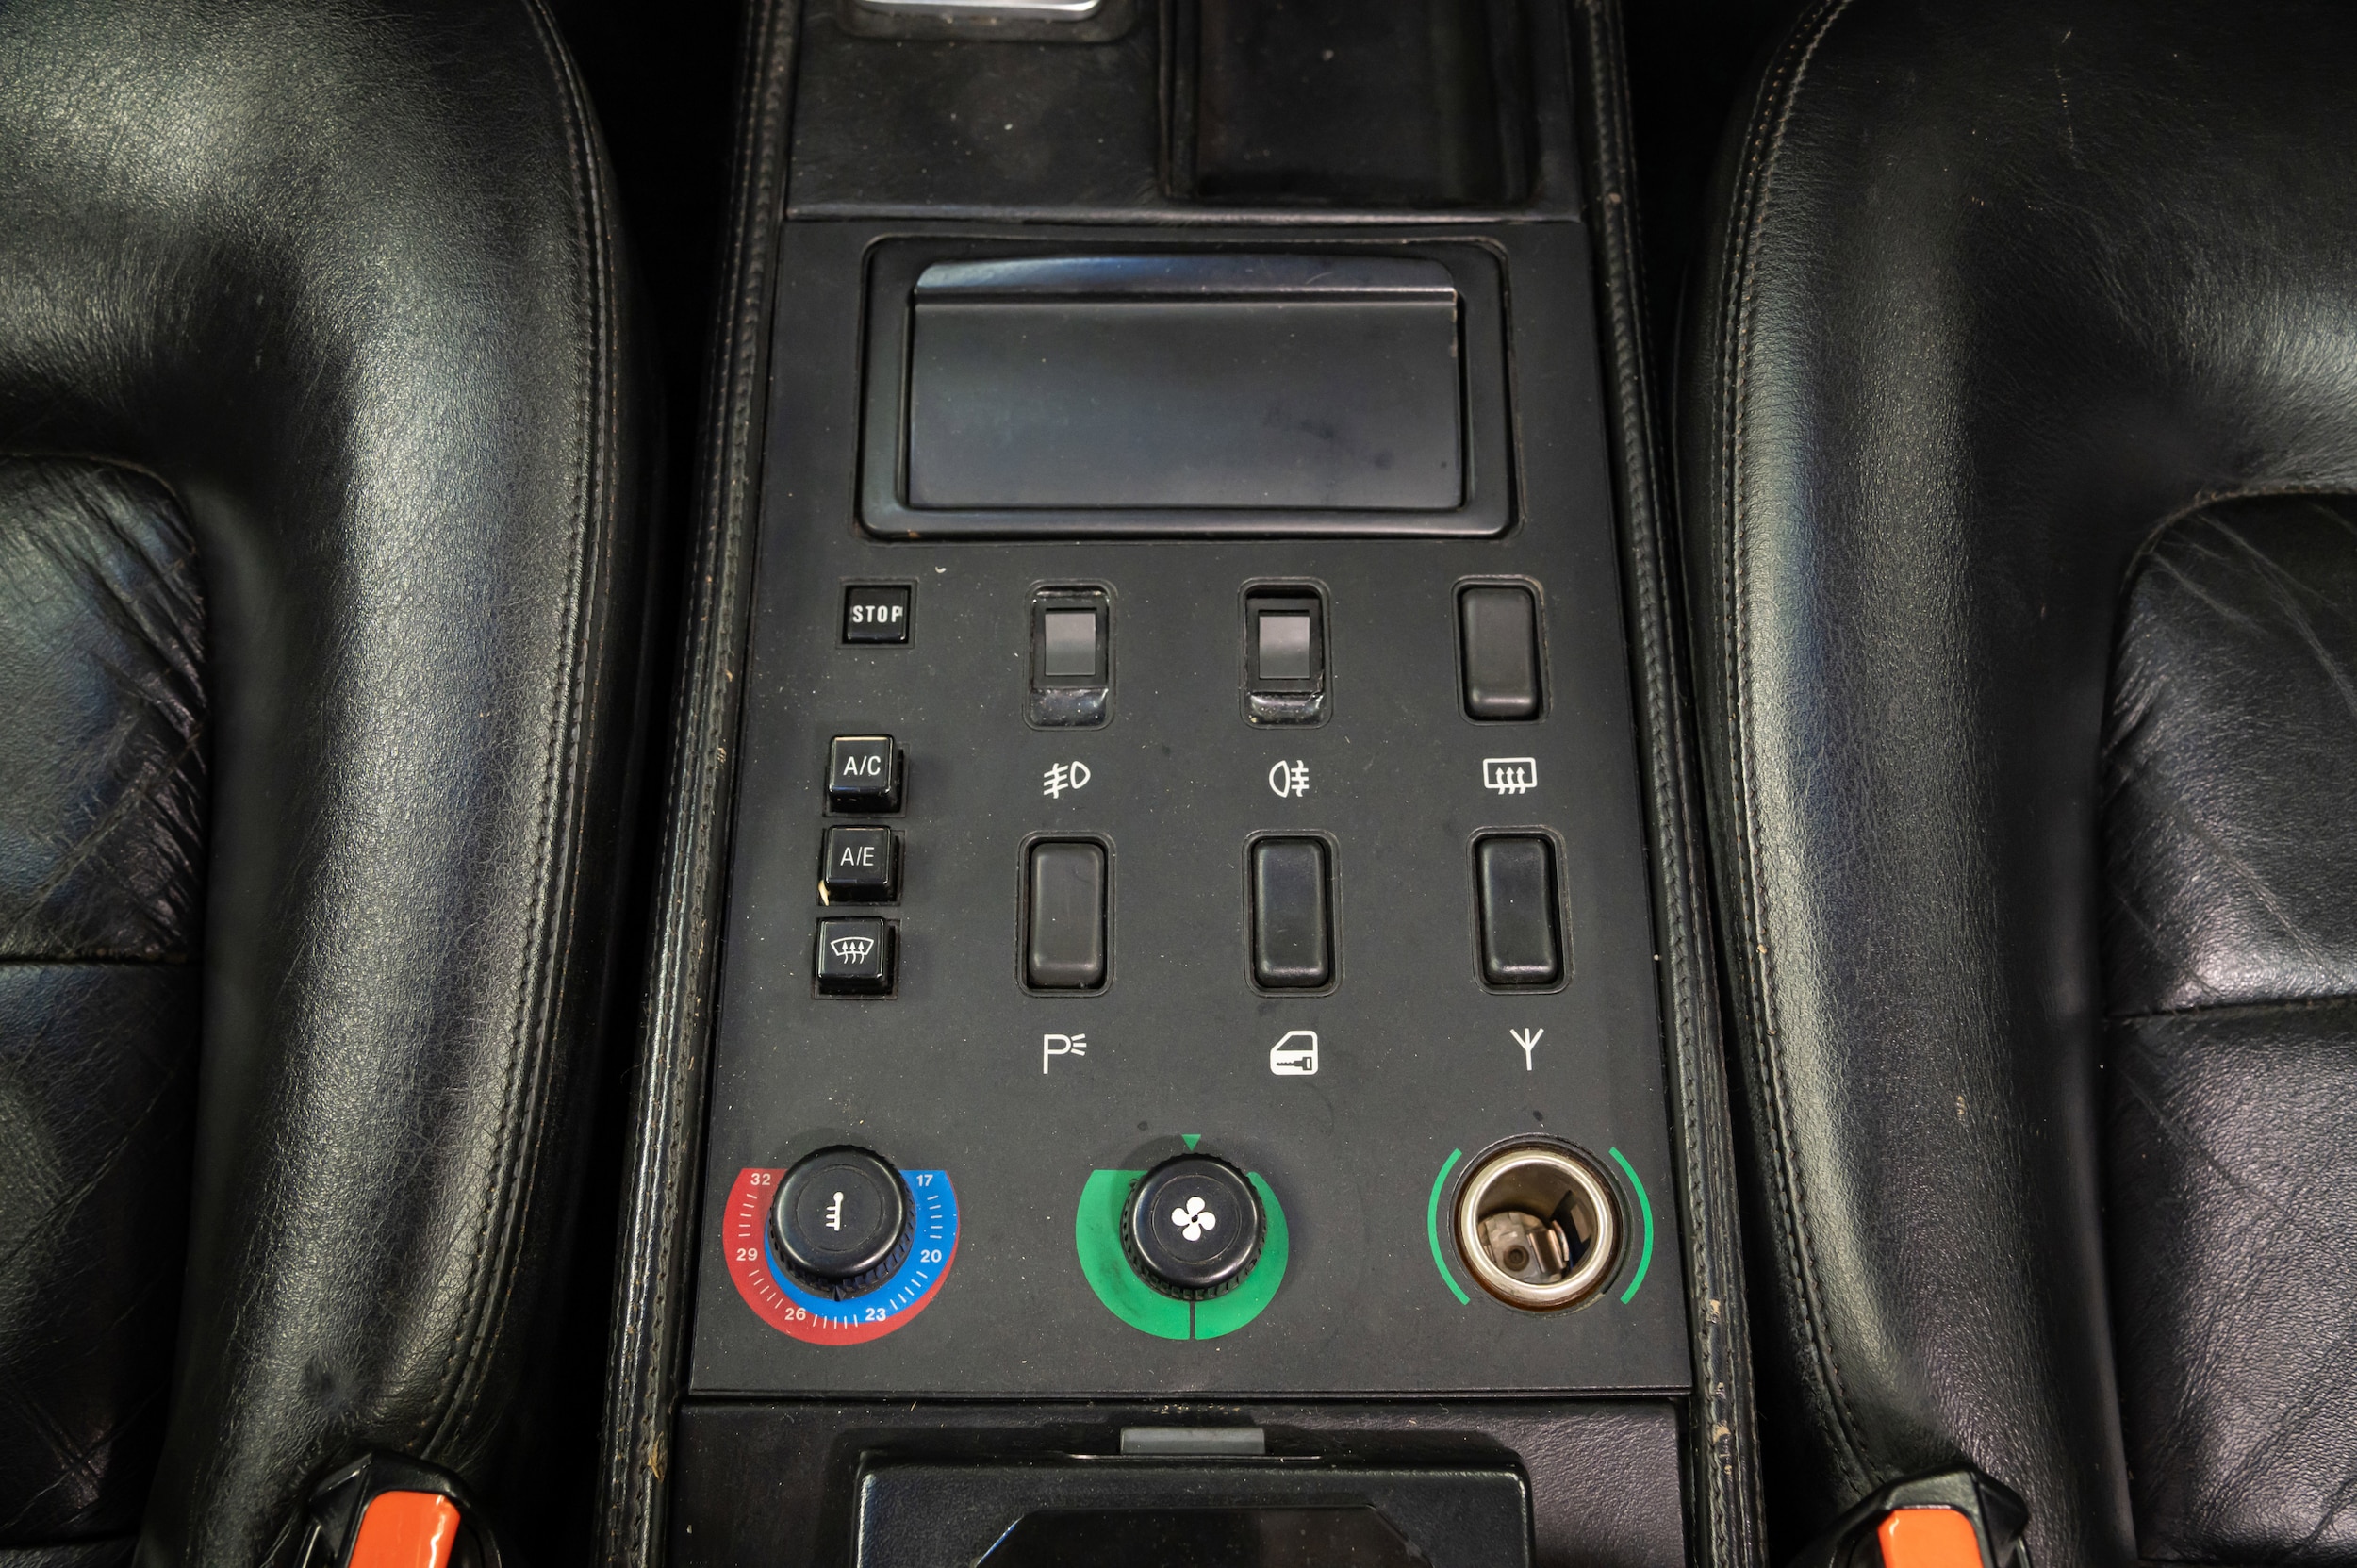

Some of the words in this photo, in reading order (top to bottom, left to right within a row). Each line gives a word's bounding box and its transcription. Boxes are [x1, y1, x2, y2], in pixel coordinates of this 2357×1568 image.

[852, 605, 903, 623] STOP
[843, 755, 882, 776] A/C
[840, 846, 875, 867] A/E
[750, 1172, 771, 1186] 32
[916, 1174, 933, 1187] 17
[735, 1247, 758, 1262] 29
[920, 1248, 942, 1263] 20
[784, 1306, 807, 1321] 26
[865, 1307, 887, 1322] 23
